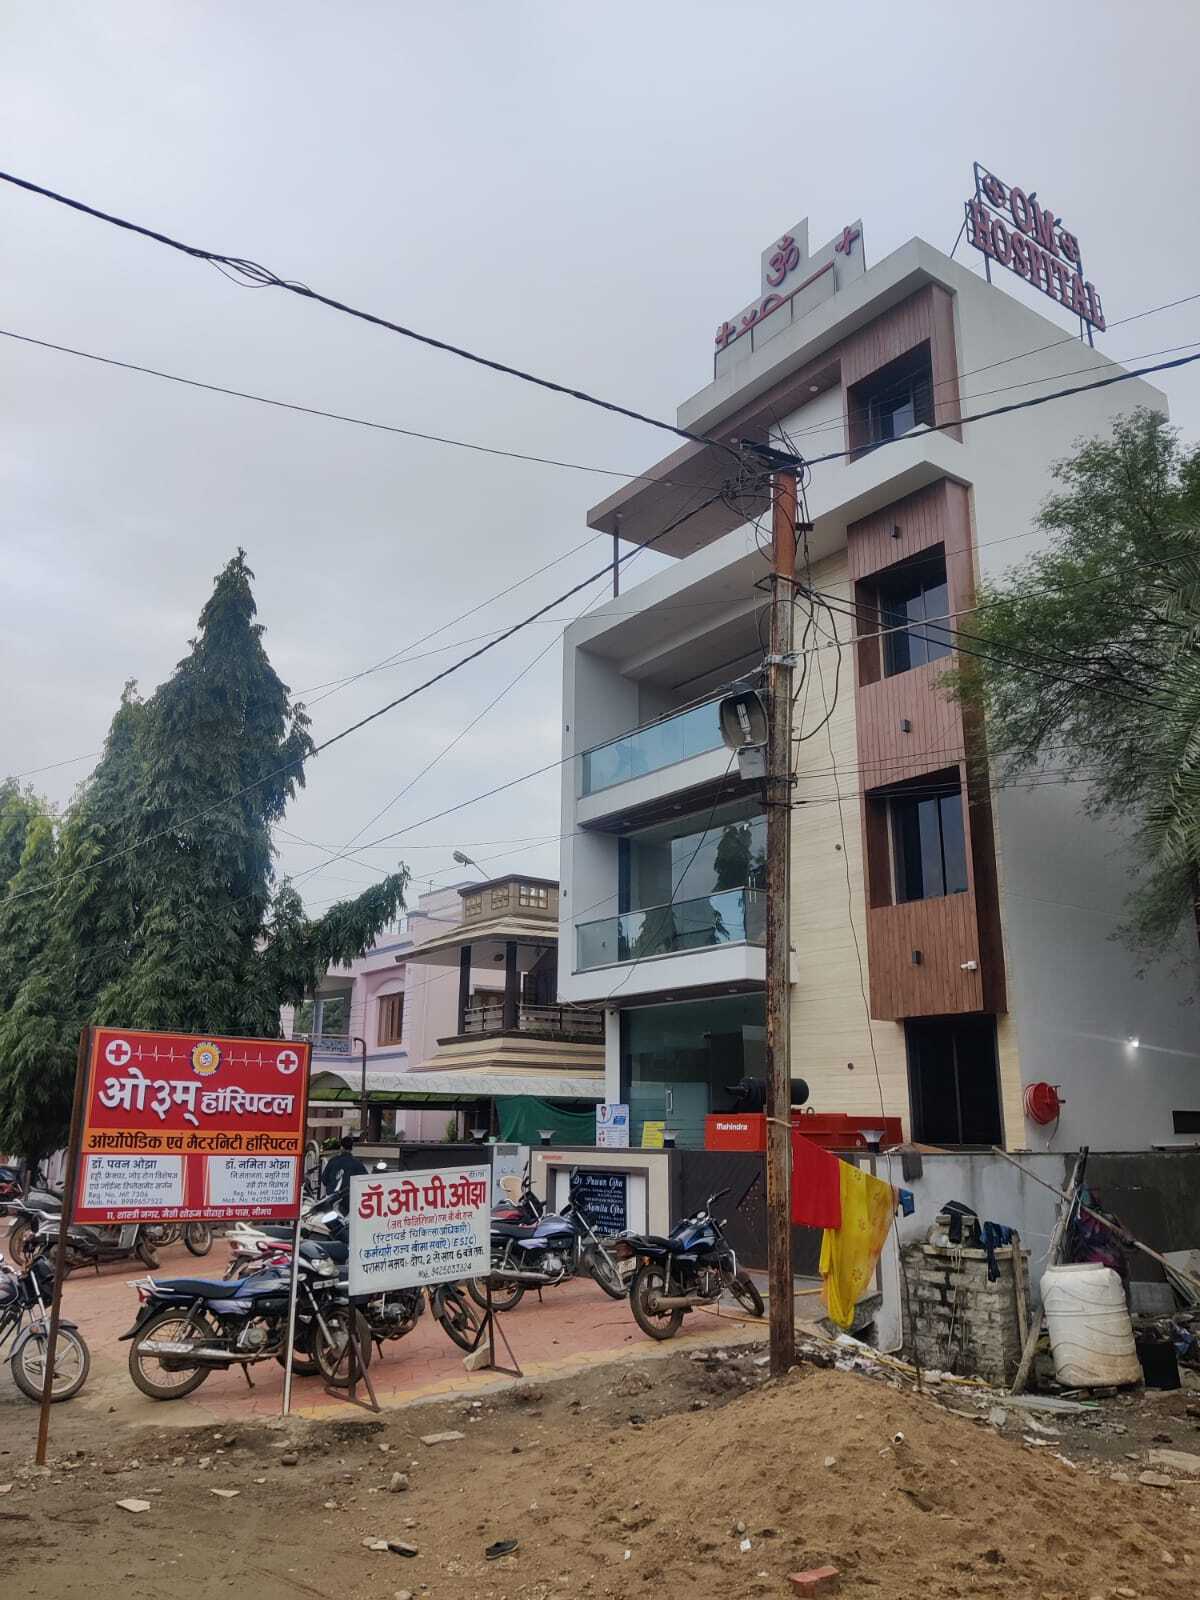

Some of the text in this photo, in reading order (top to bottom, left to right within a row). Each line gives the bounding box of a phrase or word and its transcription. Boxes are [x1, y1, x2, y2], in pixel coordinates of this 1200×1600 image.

[968, 199, 1105, 332] HOSPITAL
[200, 1086, 295, 1115] हॉस्पिटल
[716, 1122, 748, 1131] Mahindra
[166, 1132, 183, 1150] एवं
[187, 1133, 242, 1151] मैटरनिटी
[246, 1134, 298, 1152] हॉस्पिटल
[107, 1159, 130, 1169] पवन
[132, 1157, 158, 1169] ओझा
[238, 1158, 267, 1169] नमिता
[268, 1158, 290, 1169] ओझा
[456, 1250, 462, 1260] 6
